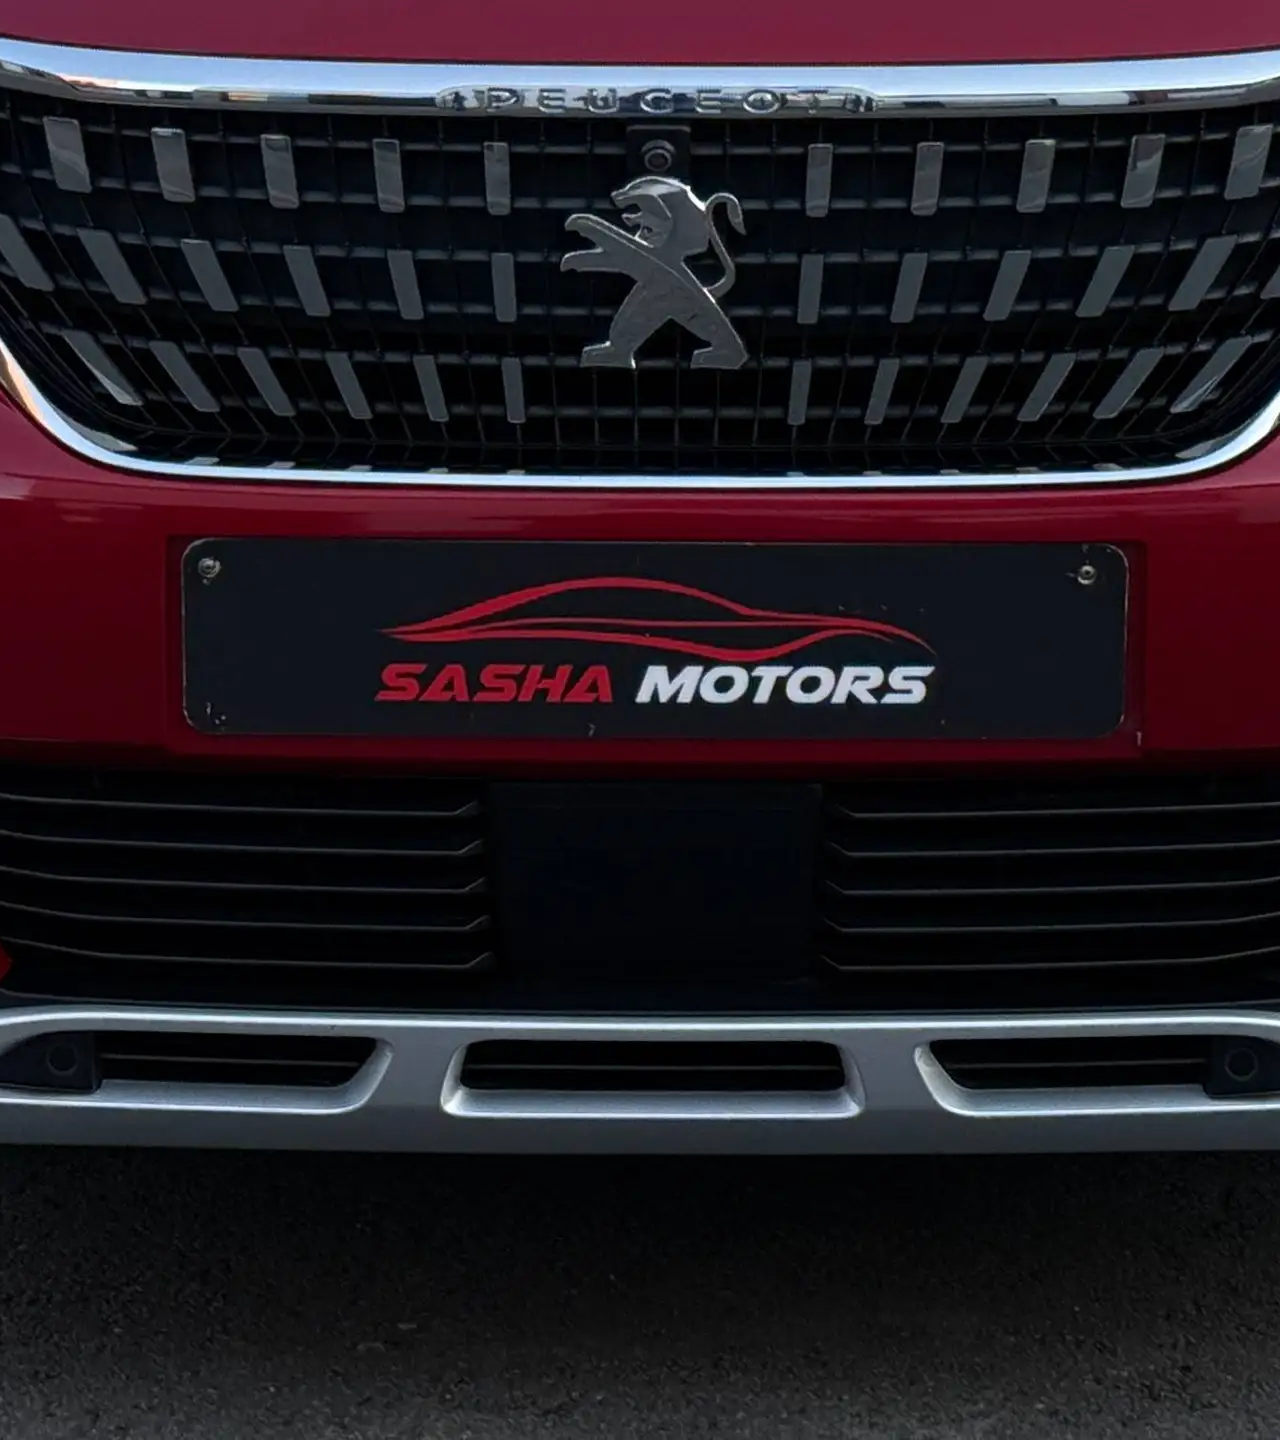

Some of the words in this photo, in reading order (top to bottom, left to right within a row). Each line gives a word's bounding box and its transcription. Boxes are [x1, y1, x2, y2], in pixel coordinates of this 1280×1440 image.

[486, 86, 829, 114] PEUGEOT
[373, 663, 614, 702] SASHA
[634, 664, 936, 705] MOTORS
